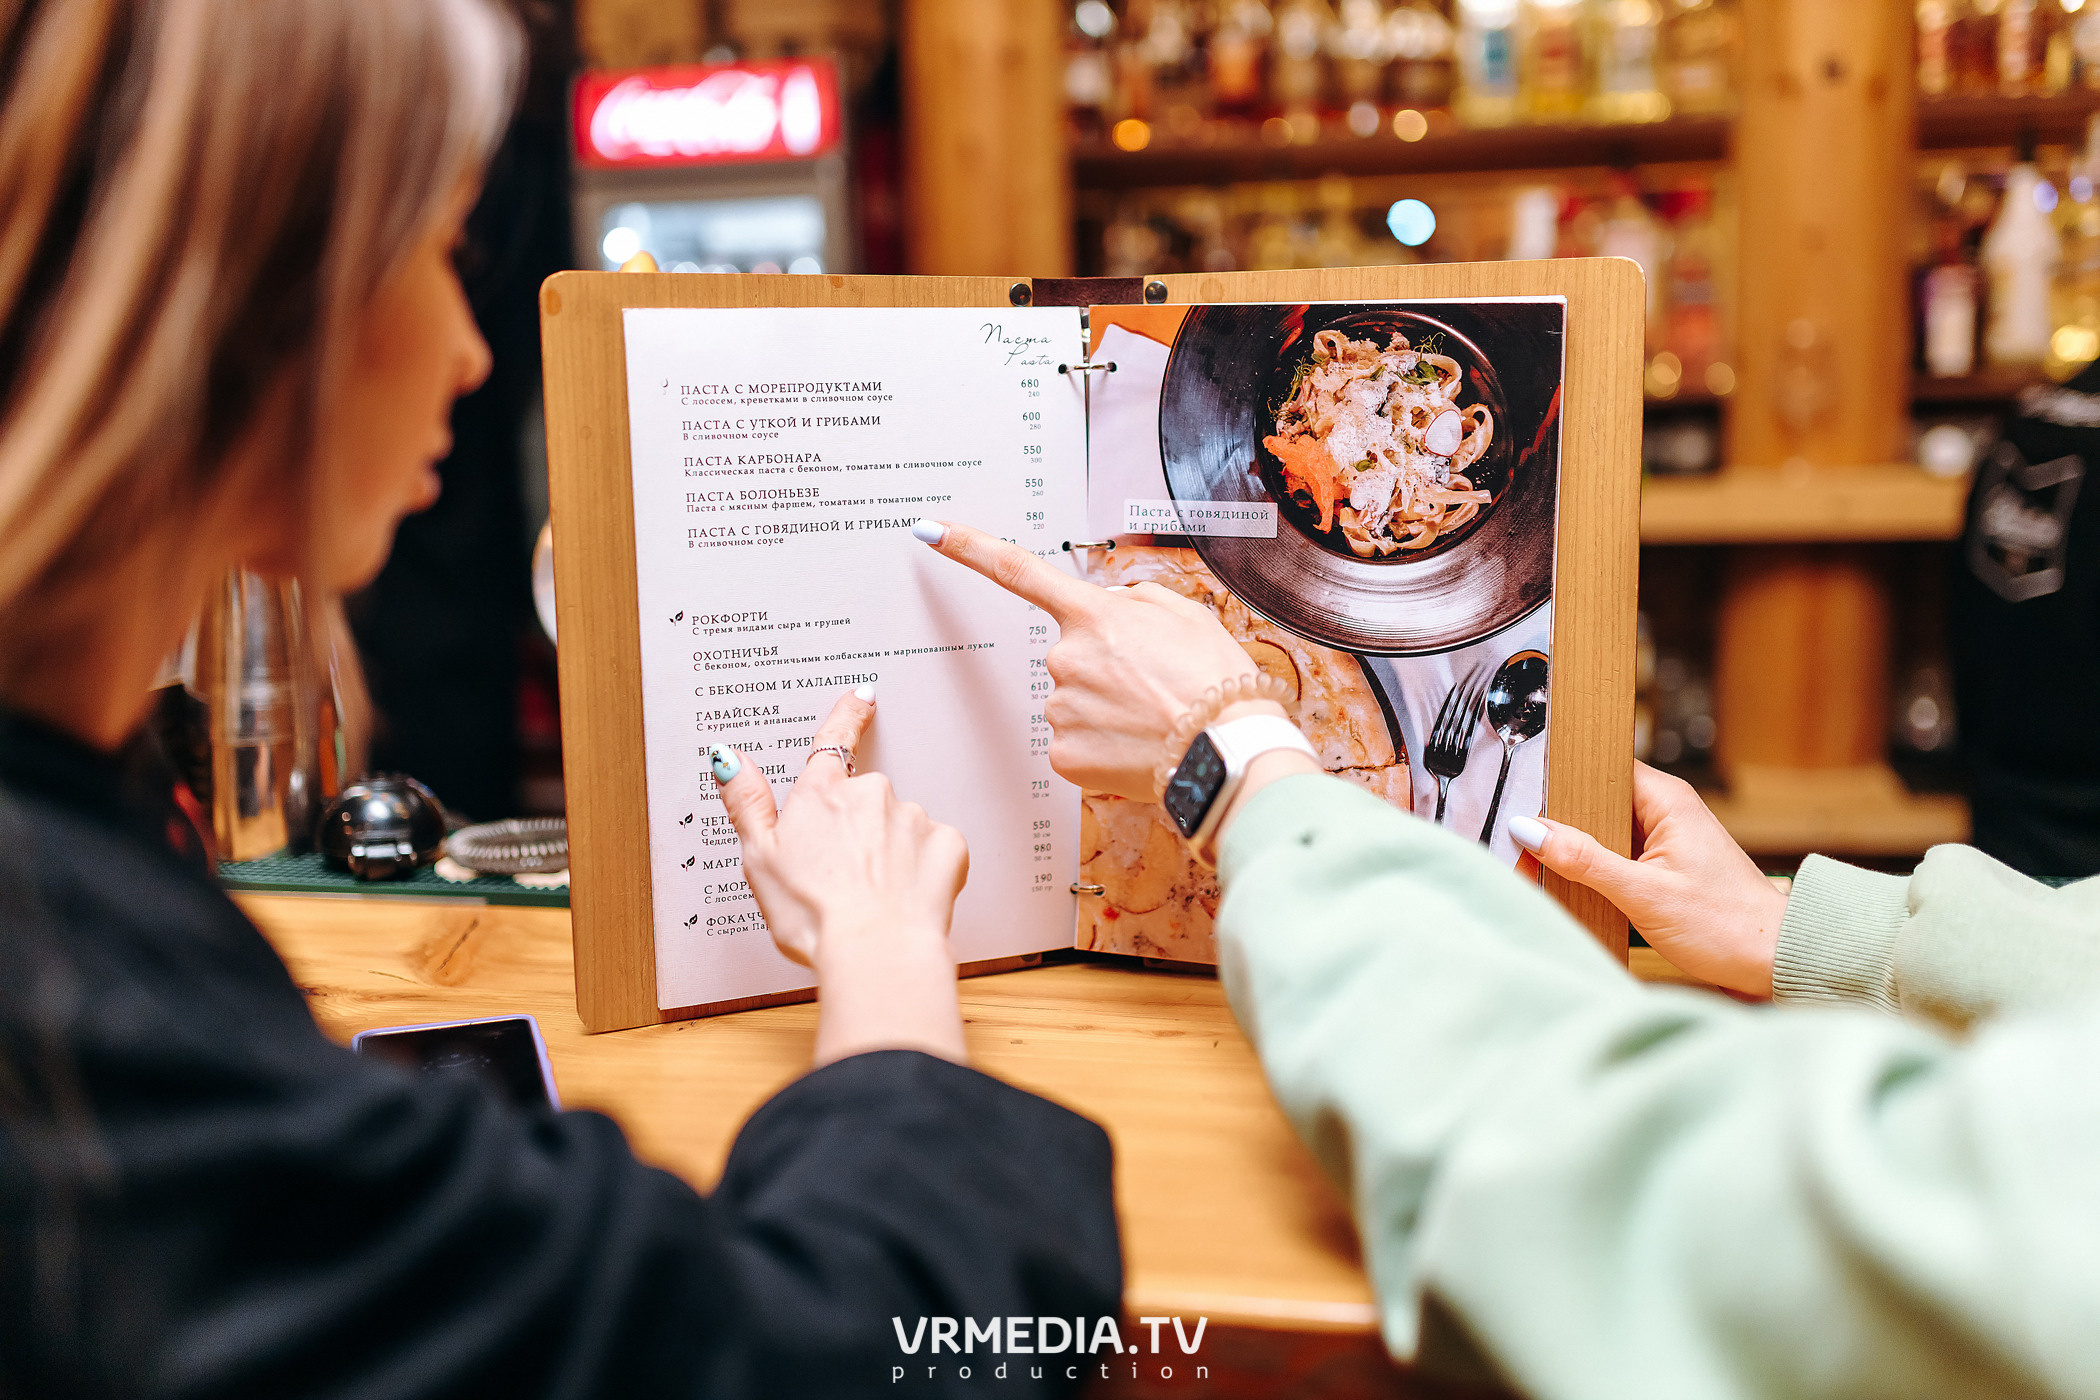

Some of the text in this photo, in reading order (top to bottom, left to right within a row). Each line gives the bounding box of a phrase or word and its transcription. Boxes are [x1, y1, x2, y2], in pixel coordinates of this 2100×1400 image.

[980, 323, 1052, 344] Паста
[1004, 343, 1054, 366] Pasta
[680, 381, 882, 395] ПАСТА С МОРЕПРОДУКТАМИ
[1021, 379, 1040, 388] 680
[681, 397, 689, 405] С
[692, 397, 737, 406] лососем,
[740, 396, 799, 406] креветками
[867, 394, 893, 403] соусе
[1022, 411, 1041, 421] 600
[682, 416, 881, 431] ПАСТА С УТКОЙ И ГРИБАМИ
[683, 431, 779, 441] В сливочном соусе
[1023, 445, 1042, 454] 550
[684, 453, 822, 467] ПАСТА КАРБОНАРА
[684, 467, 755, 477] Классическая
[758, 466, 787, 475] паста
[797, 464, 843, 474] беконом,
[845, 463, 893, 471] томатами
[903, 460, 954, 468] сливочном
[957, 459, 983, 469] соусе
[1025, 478, 1044, 487] 550
[686, 487, 820, 503] ПАСТА БОЛОНЬЕЗЕ
[686, 504, 717, 513] Паста
[728, 502, 768, 511] мясным
[771, 500, 815, 511] фаршем,
[819, 498, 866, 507] томатами
[878, 496, 923, 504] томатном
[926, 494, 952, 504] соусе
[1026, 512, 1044, 521] 580
[1129, 505, 1269, 520] Паста с говядиной
[688, 527, 736, 538] ПАСТА
[741, 525, 750, 536] С
[755, 520, 840, 535] ГОВЯДИНОЙ
[845, 521, 855, 530] И
[1143, 520, 1207, 533] грибами
[689, 537, 784, 548] В сливочном соусе
[692, 612, 768, 625] РОКФОРТИ
[692, 627, 700, 635] С
[703, 627, 733, 636] тремя
[737, 624, 774, 632] видами
[777, 622, 801, 631] сыра
[815, 618, 851, 629] грушей
[1029, 626, 1047, 635] 750
[693, 646, 779, 662] ОХОТНИЧЬЯ
[694, 663, 701, 671] С
[704, 660, 751, 671] беконом,
[754, 656, 821, 667] охотничьими
[824, 650, 881, 662] колбасками
[893, 644, 964, 657] маринованным
[967, 641, 995, 651] луком
[1030, 658, 1047, 668] 780
[695, 672, 878, 697] С БЕКОНОМ И ХАЛАПЕНЬО
[1031, 681, 1049, 691] 610
[696, 705, 780, 722] ГАВАЙСКАЯ
[696, 723, 704, 731] С
[707, 719, 750, 732] курицей
[764, 714, 816, 725] ананасами
[1031, 714, 1047, 724] 550
[698, 741, 763, 756] ВИНА
[777, 736, 815, 749] ГРИБ
[1031, 737, 1048, 747] 710
[781, 775, 799, 784] сыр
[699, 783, 707, 791] С
[1032, 780, 1049, 790] 710
[1033, 820, 1050, 830] 550
[701, 828, 708, 837] С
[701, 837, 738, 846] Чеддер
[1034, 843, 1051, 853] 980
[1035, 873, 1052, 883] 190
[704, 885, 713, 895] С
[704, 896, 711, 904] С
[706, 911, 765, 926] ФОКАЧЧ
[717, 926, 749, 936] сыром
